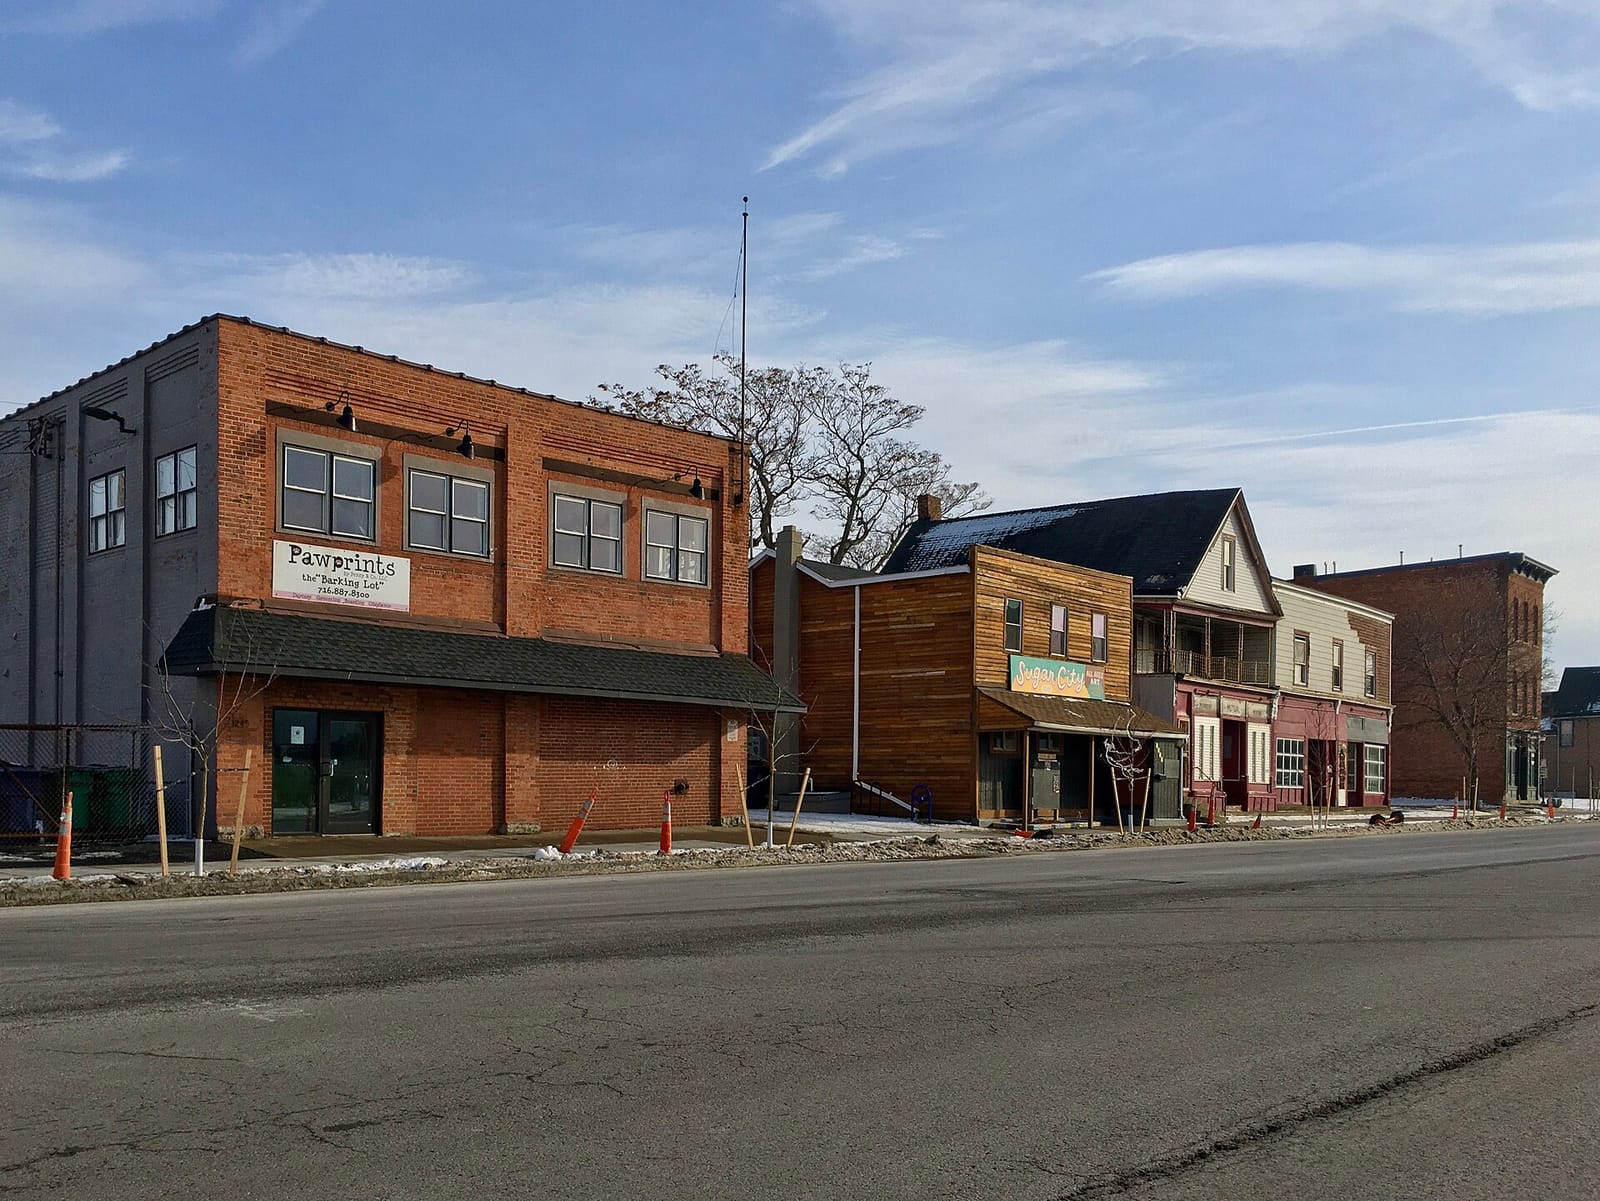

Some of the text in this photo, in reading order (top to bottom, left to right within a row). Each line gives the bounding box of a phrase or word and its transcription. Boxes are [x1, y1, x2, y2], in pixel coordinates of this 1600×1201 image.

[288, 544, 396, 576] Pawprints
[302, 573, 317, 582] the
[317, 586, 370, 599] 716.887.8300
[1016, 660, 1086, 692] Sugar City
